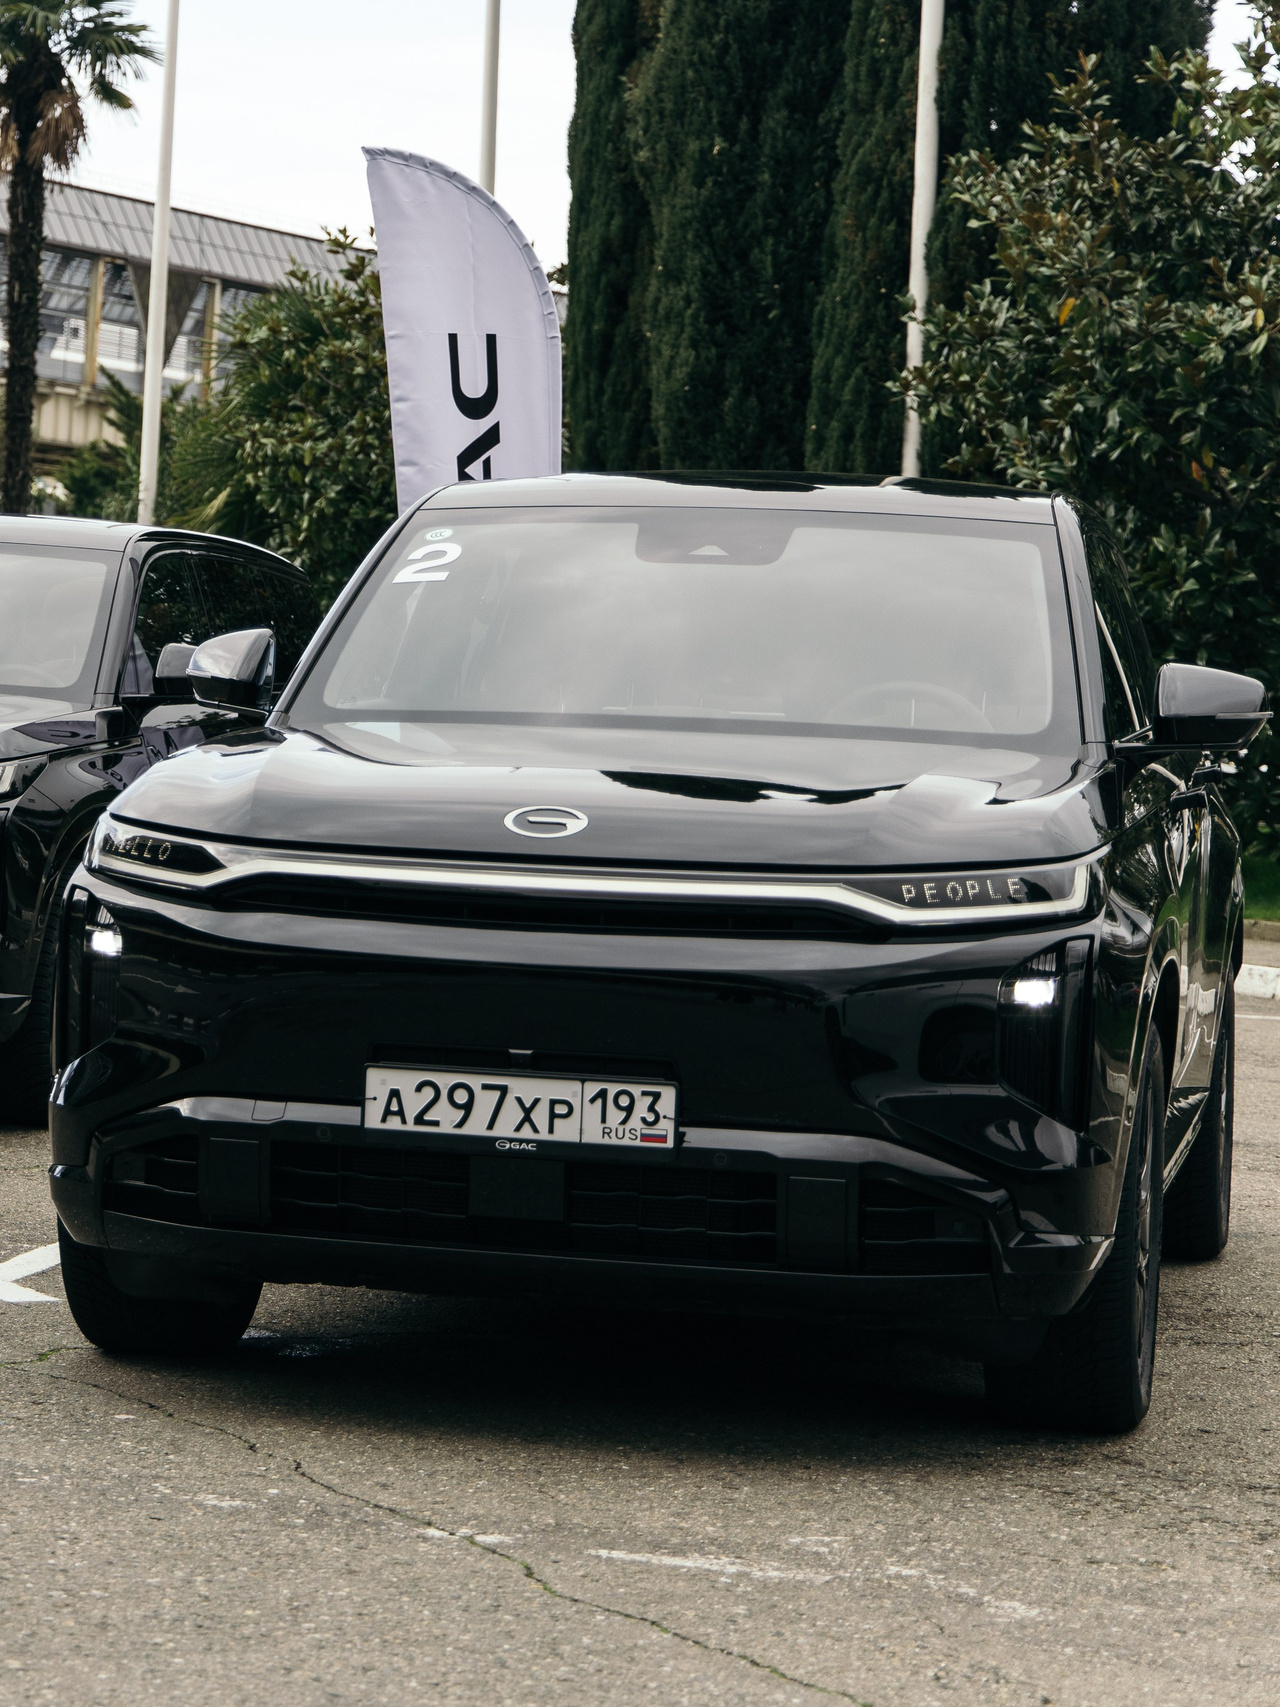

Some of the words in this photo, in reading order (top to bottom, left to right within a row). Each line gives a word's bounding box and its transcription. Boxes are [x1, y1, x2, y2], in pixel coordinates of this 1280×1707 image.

[447, 333, 500, 481] AC
[392, 542, 462, 584] 2
[901, 877, 1024, 903] PEOPLE
[380, 1078, 574, 1134] А297ХР
[588, 1087, 662, 1126] 193
[511, 1141, 537, 1150] GAC
[601, 1126, 639, 1142] RUS
